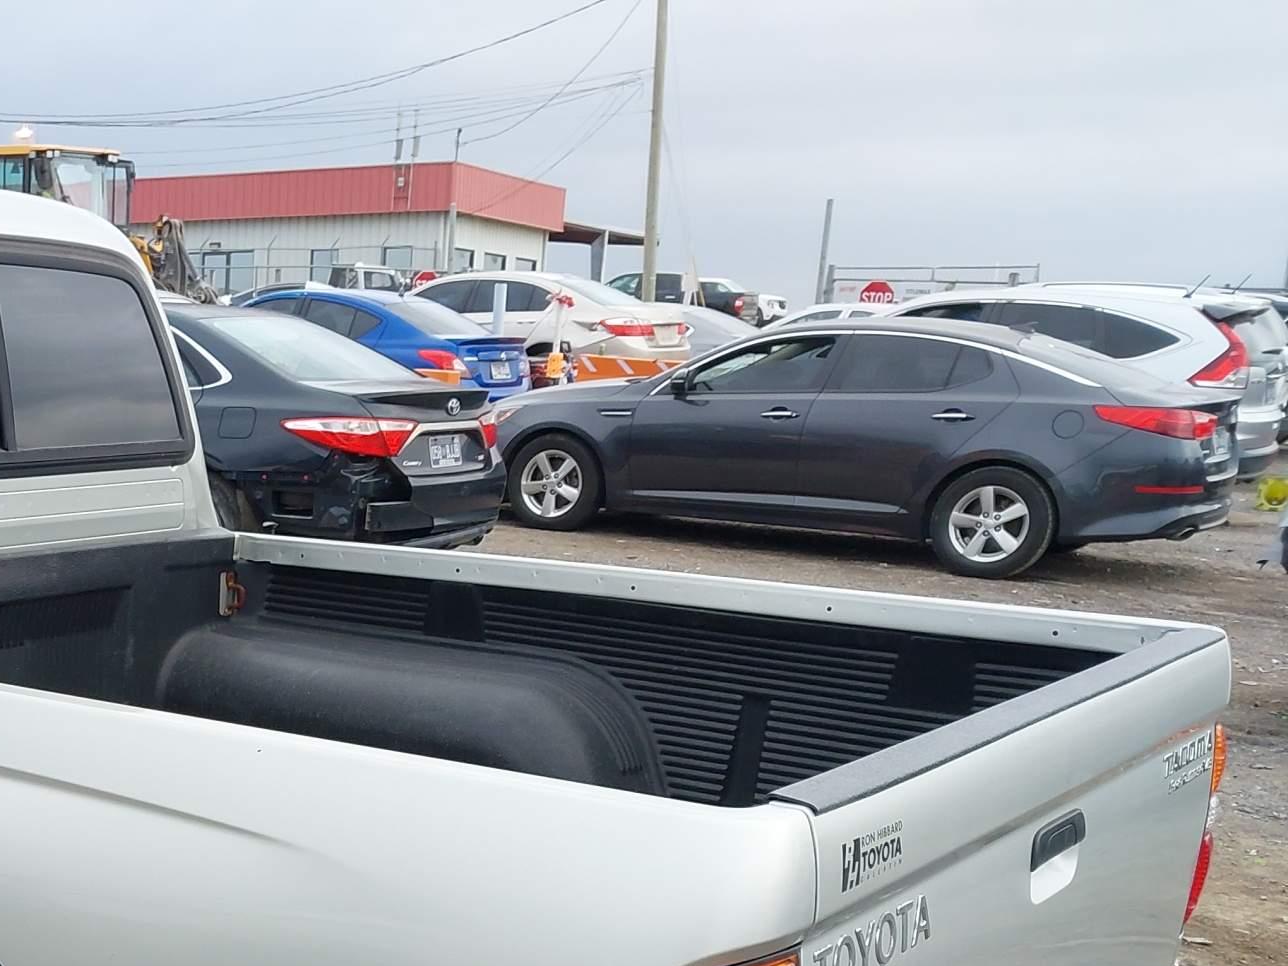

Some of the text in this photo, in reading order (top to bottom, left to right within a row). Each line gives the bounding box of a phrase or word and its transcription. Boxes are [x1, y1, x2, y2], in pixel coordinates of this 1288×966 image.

[862, 292, 892, 304] STOP
[861, 831, 876, 847] RON
[861, 836, 902, 873] TOYOTA
